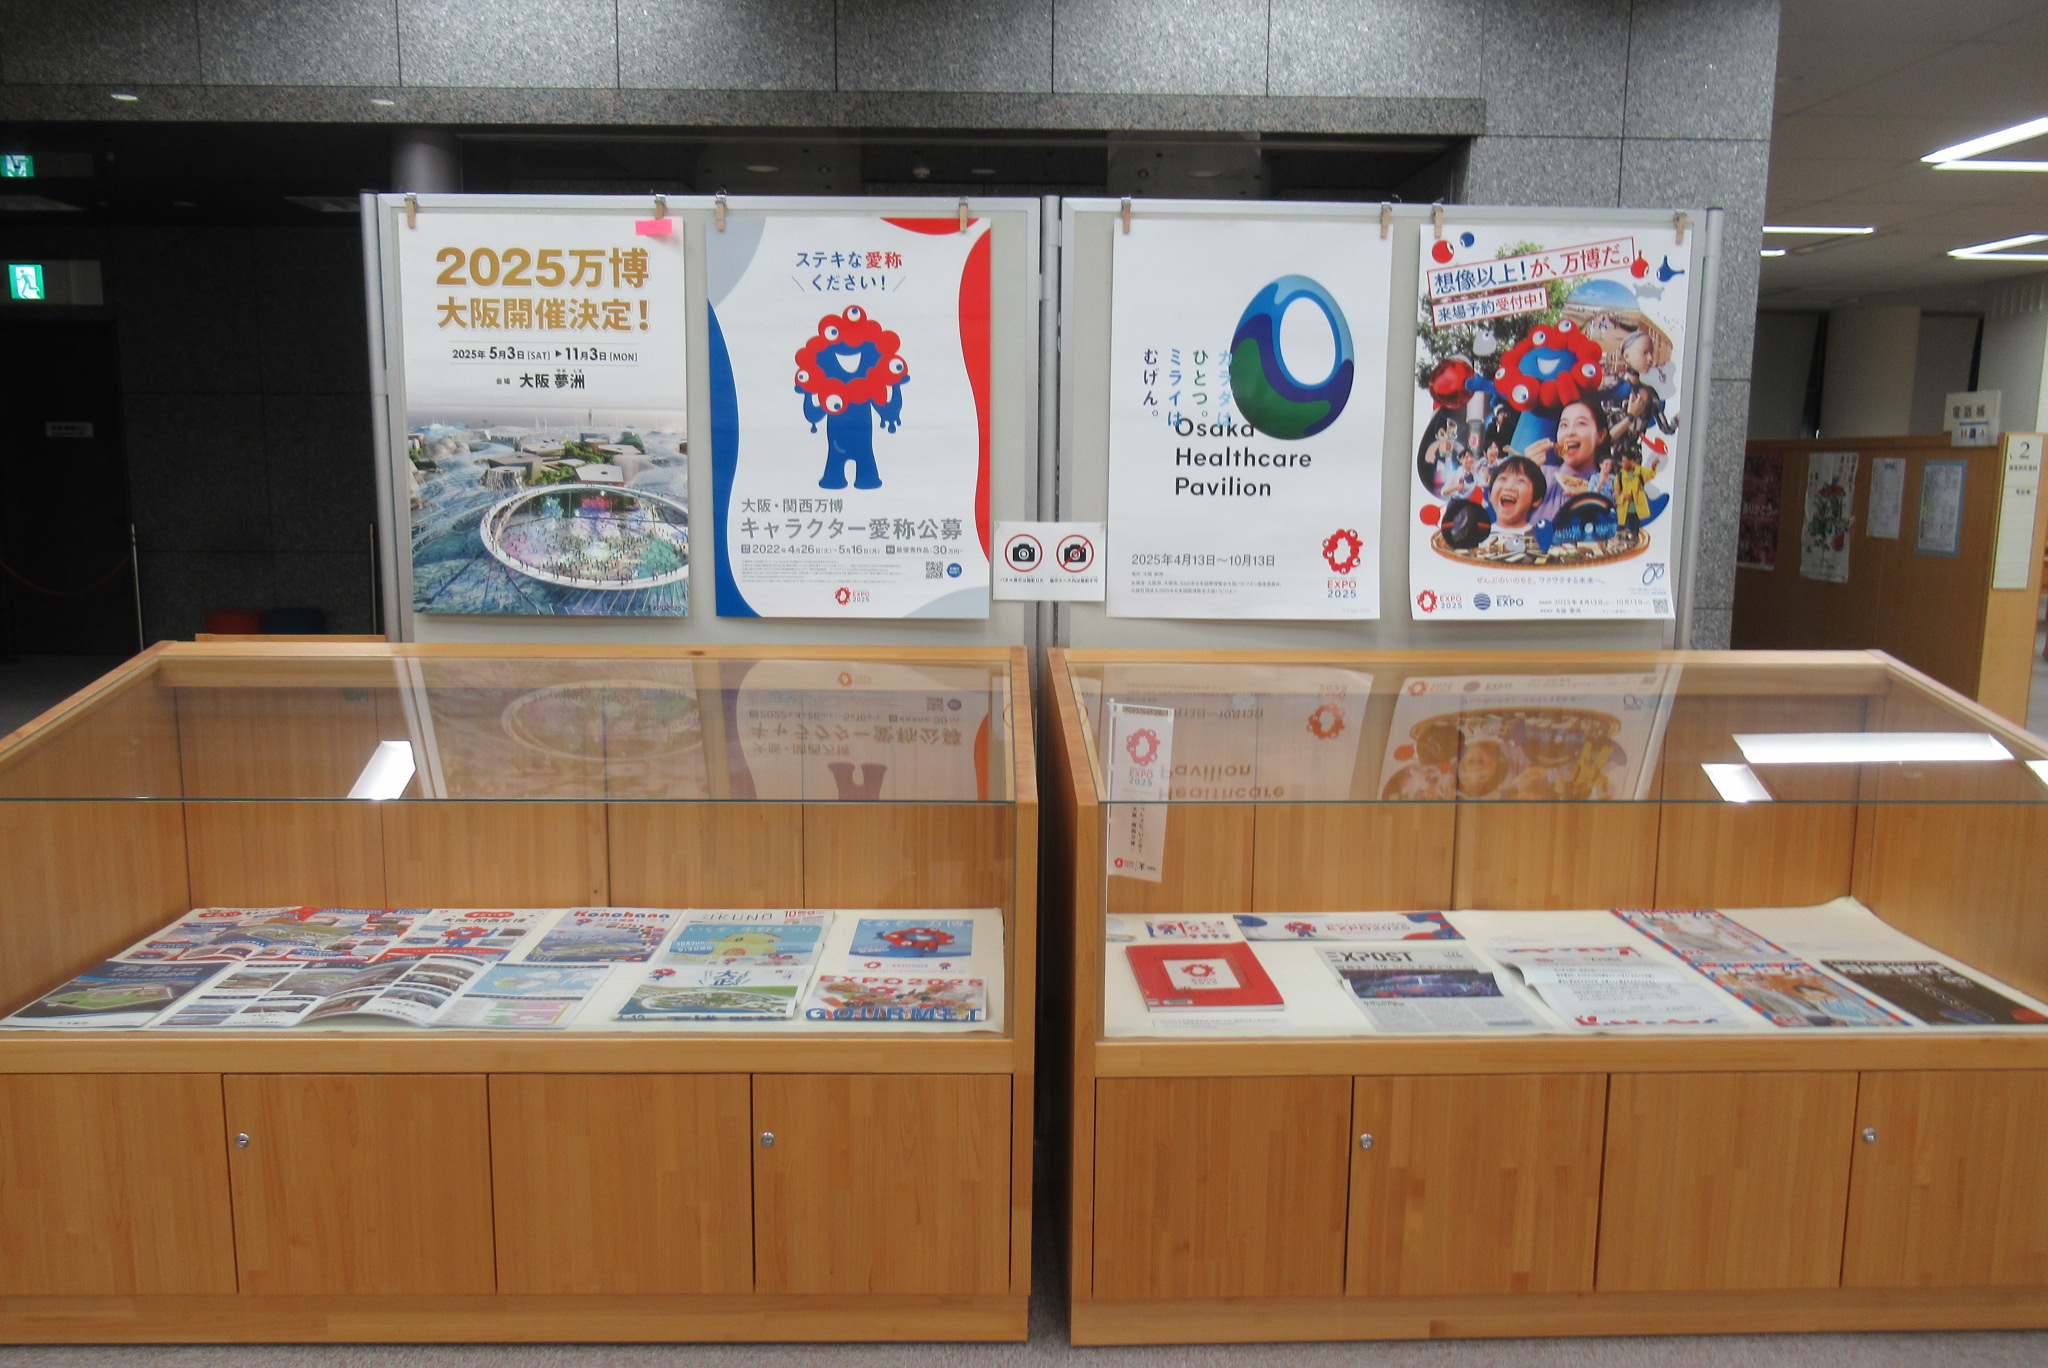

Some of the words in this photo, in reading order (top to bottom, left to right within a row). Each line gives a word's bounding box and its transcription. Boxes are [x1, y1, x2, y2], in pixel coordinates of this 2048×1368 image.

[436, 246, 650, 289] 2025万博
[796, 251, 903, 269] ステキな愛称
[453, 349, 486, 360] 2025年
[489, 347, 525, 360] 5月3日
[565, 347, 607, 361] 11月3日
[519, 373, 550, 389] 大阪
[554, 373, 586, 390] 夢洲
[1143, 348, 1159, 418] むげん。
[1167, 349, 1183, 427] ミライは
[1192, 350, 1209, 418] ひとつ。
[1174, 416, 1255, 437] Osaka
[1175, 447, 1312, 468] Healthcare
[2019, 441, 2030, 459] 2
[1175, 476, 1272, 496] Pavilion
[741, 498, 844, 513] 大阪・関西万博
[740, 517, 963, 540] キャラクター愛称公募
[1327, 580, 1357, 589] EXPO
[1327, 589, 1357, 599] 2025
[1496, 598, 1524, 607] EXPO
[1129, 768, 1154, 778] EXPO
[1129, 777, 1153, 787] 2025
[574, 911, 670, 919] Konohana
[819, 975, 985, 987] EXPO2025
[805, 1007, 982, 1022] GOURMET
